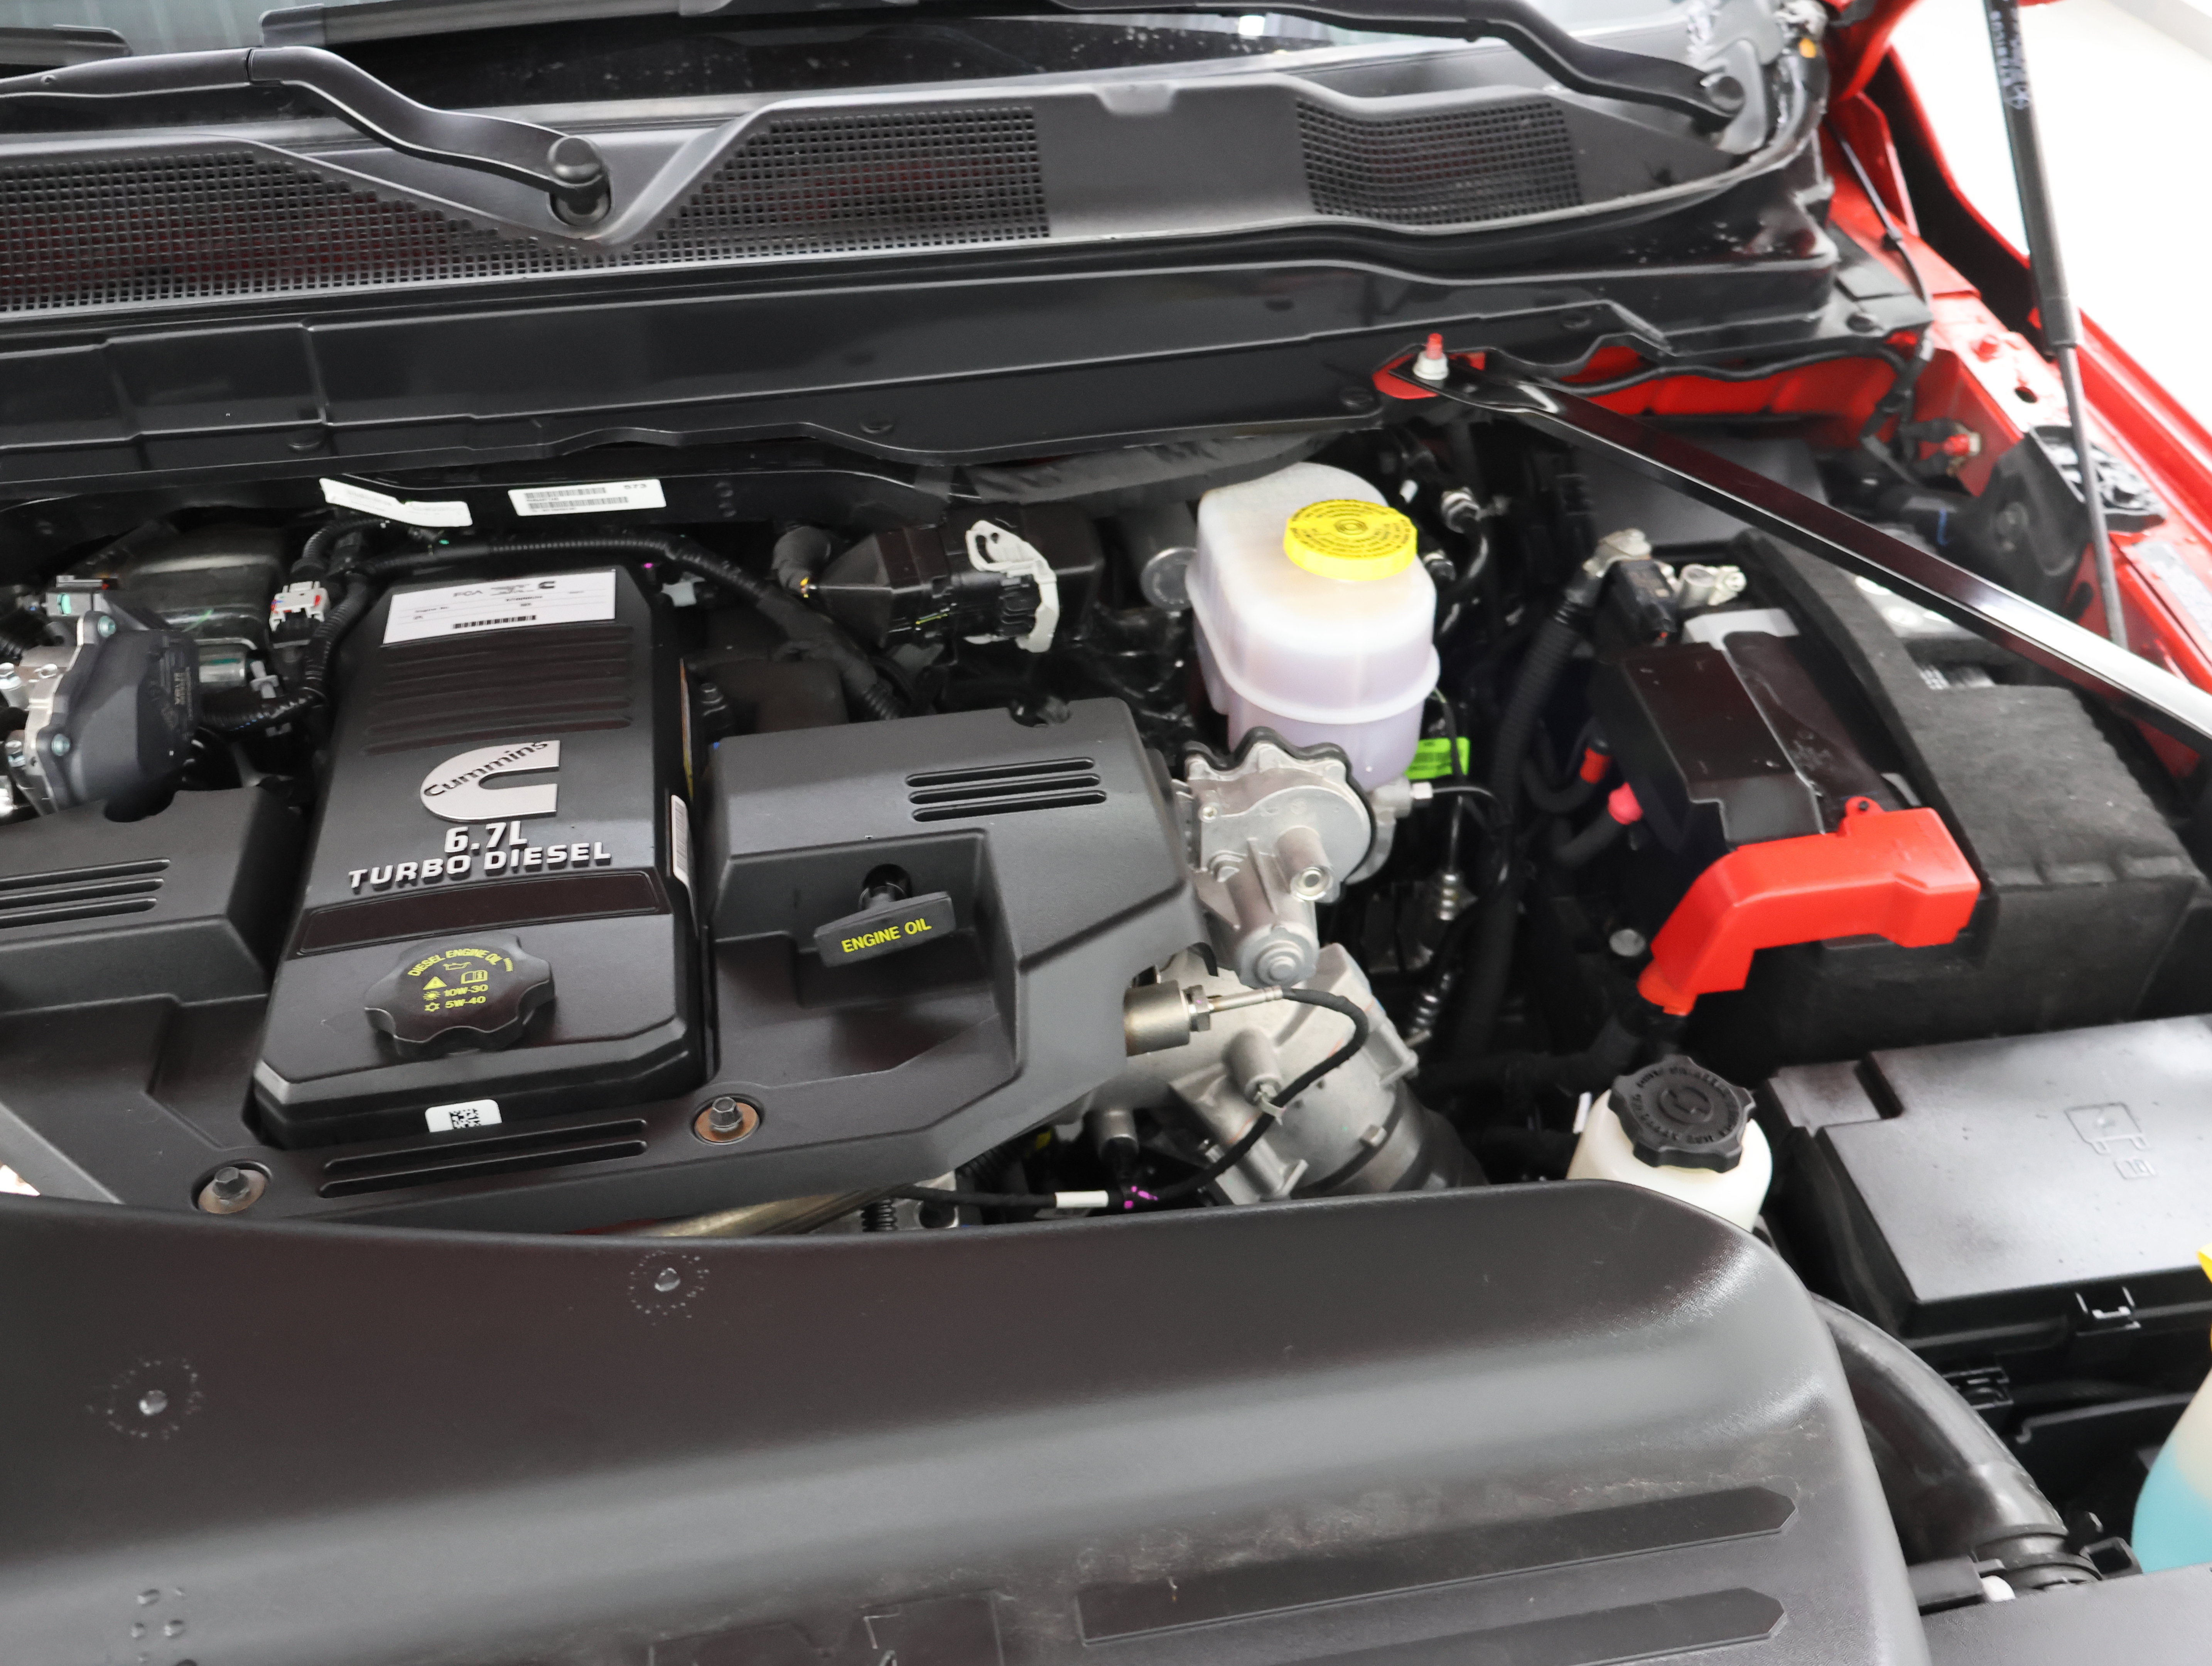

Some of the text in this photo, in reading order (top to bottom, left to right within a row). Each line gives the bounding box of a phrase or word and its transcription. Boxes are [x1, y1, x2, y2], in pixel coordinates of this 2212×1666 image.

[452, 589, 483, 597] FCA
[424, 741, 549, 797] Cummins
[444, 821, 528, 853] 6.7L
[348, 841, 612, 889] TURBO DIESEL
[841, 918, 932, 953] ENGINE OIL
[407, 954, 446, 976] DIESEL
[445, 948, 490, 958] ENGINE
[485, 953, 503, 965] OIL
[444, 984, 489, 997] 10W-30
[445, 996, 486, 1008] 5W-40
